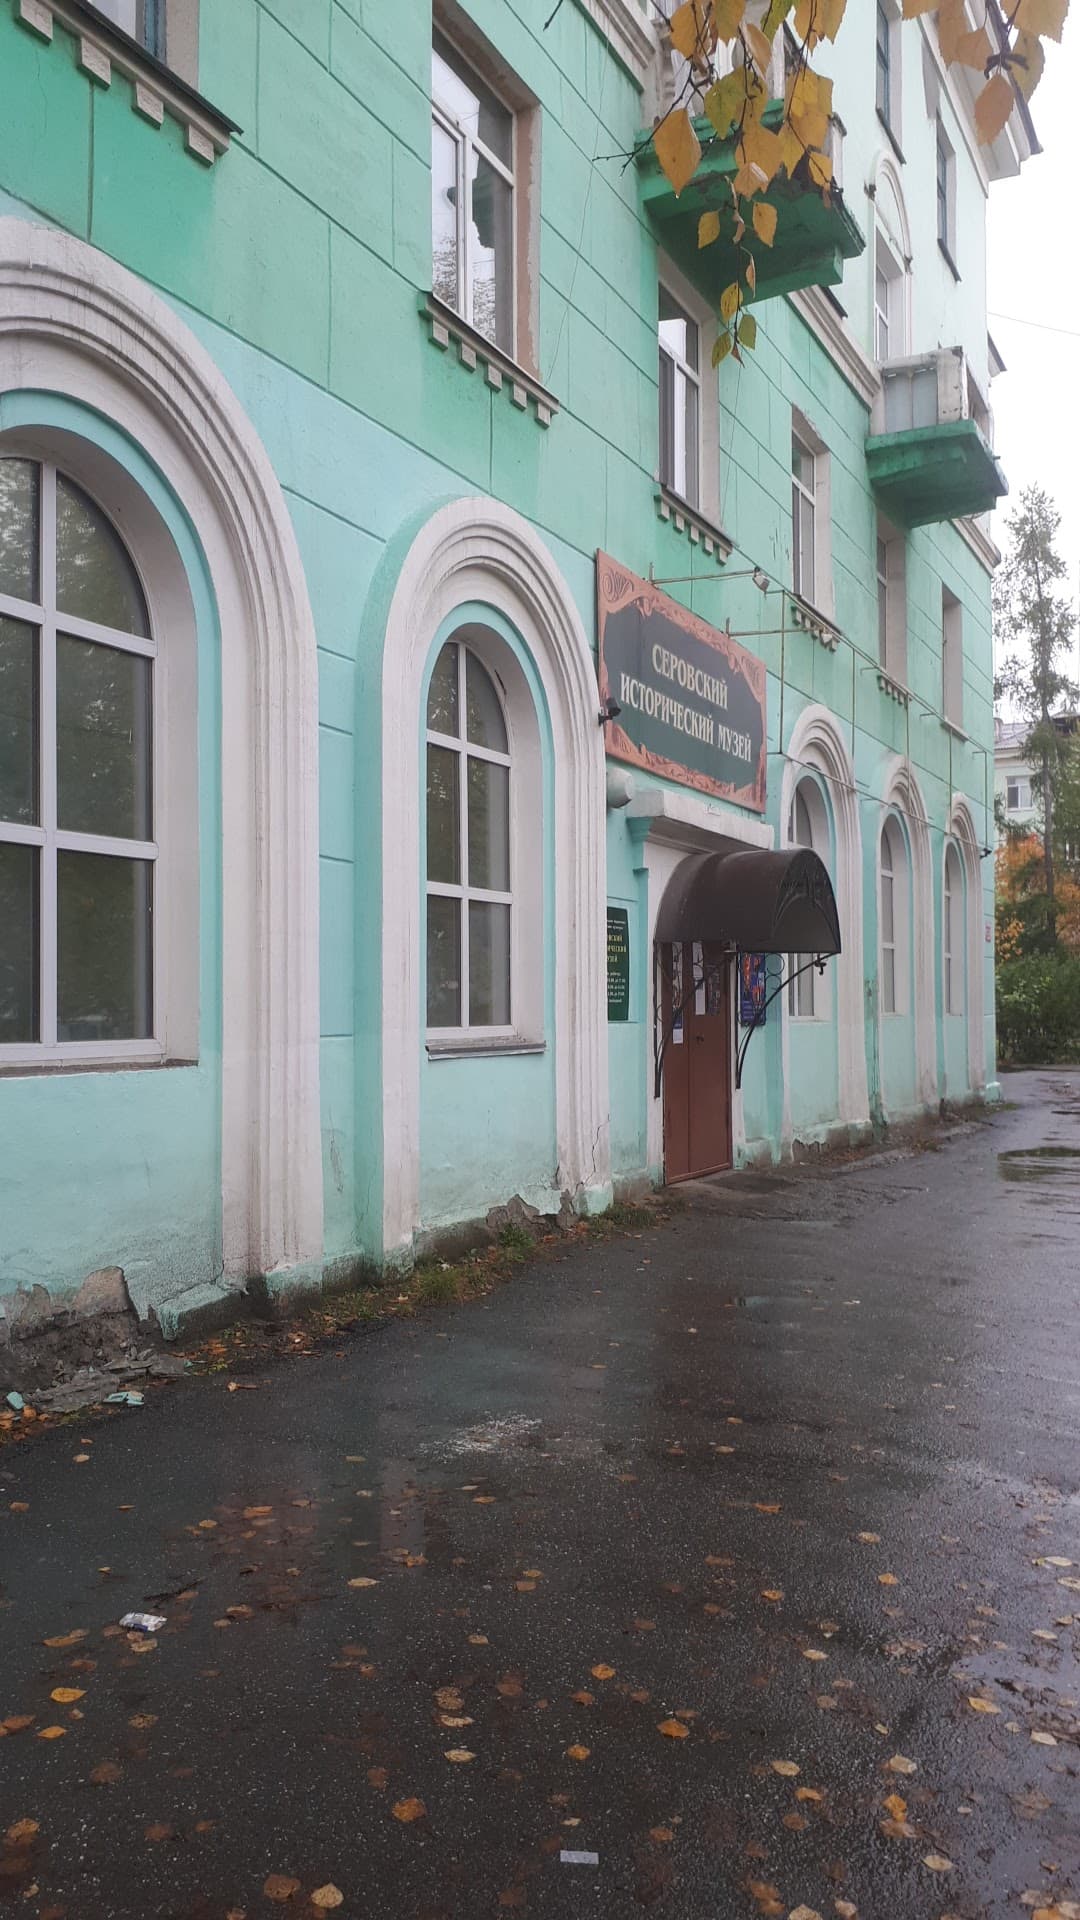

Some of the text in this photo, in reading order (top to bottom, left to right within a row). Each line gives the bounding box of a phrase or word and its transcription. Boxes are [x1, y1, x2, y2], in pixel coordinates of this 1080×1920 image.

[652, 644, 728, 710] СЕРОВСКИЙ
[620, 673, 752, 762] ИСТОРИЧЕСКИЙ МУЗЕЙ
